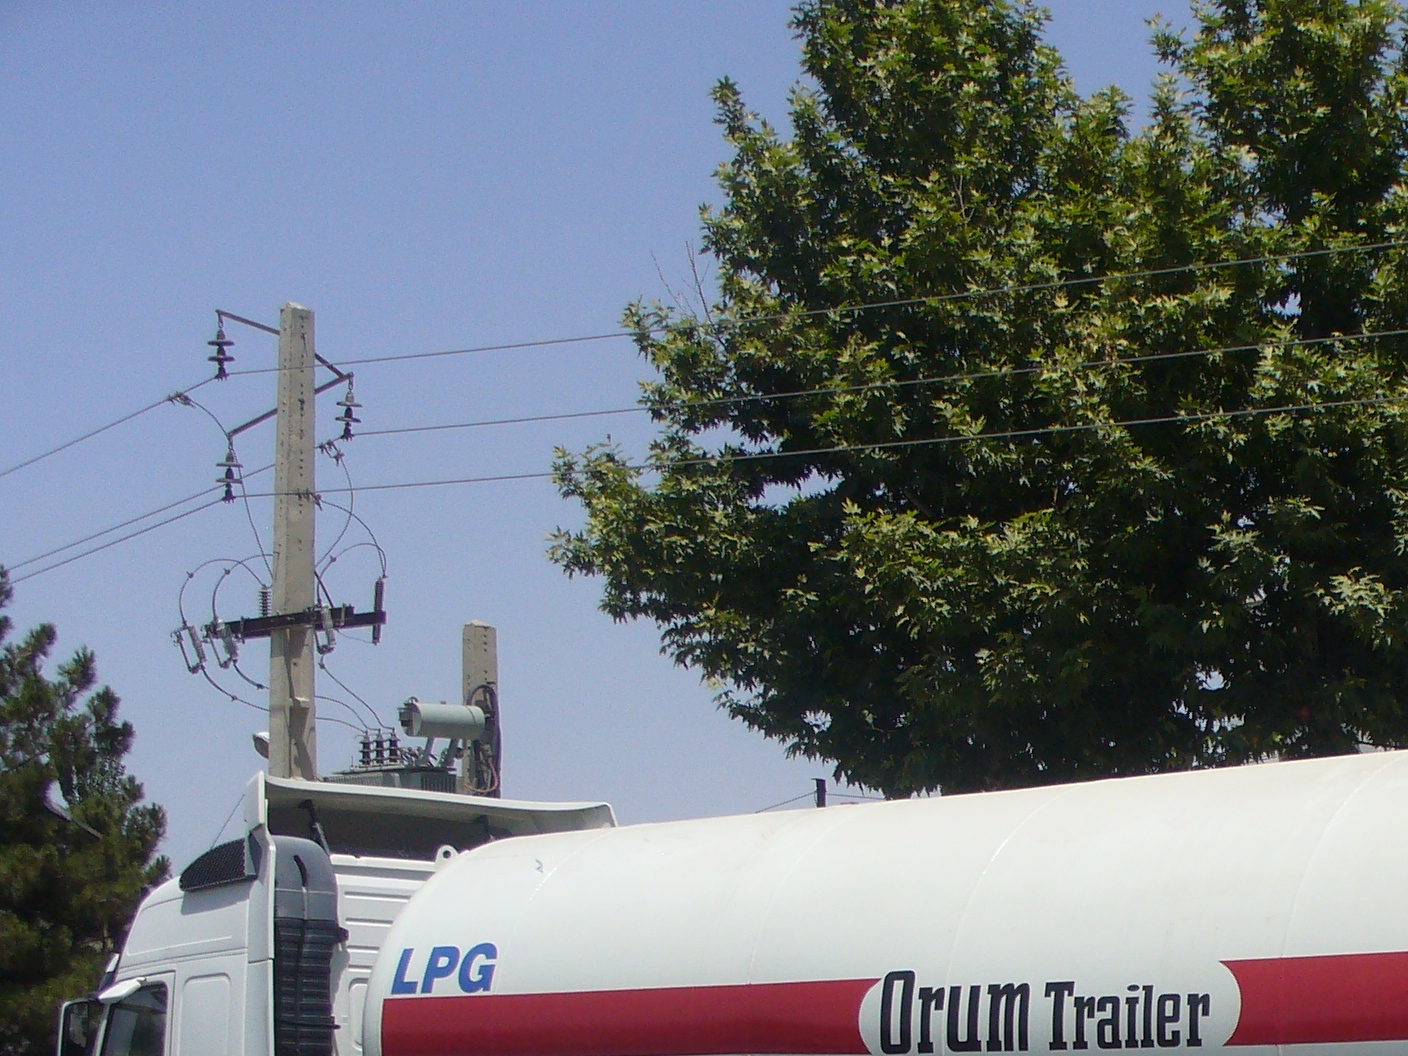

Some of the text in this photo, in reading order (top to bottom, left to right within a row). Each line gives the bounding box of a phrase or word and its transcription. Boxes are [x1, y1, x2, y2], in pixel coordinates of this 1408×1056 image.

[391, 942, 498, 995] LPG
[879, 969, 1211, 1055] Orum Trailer
